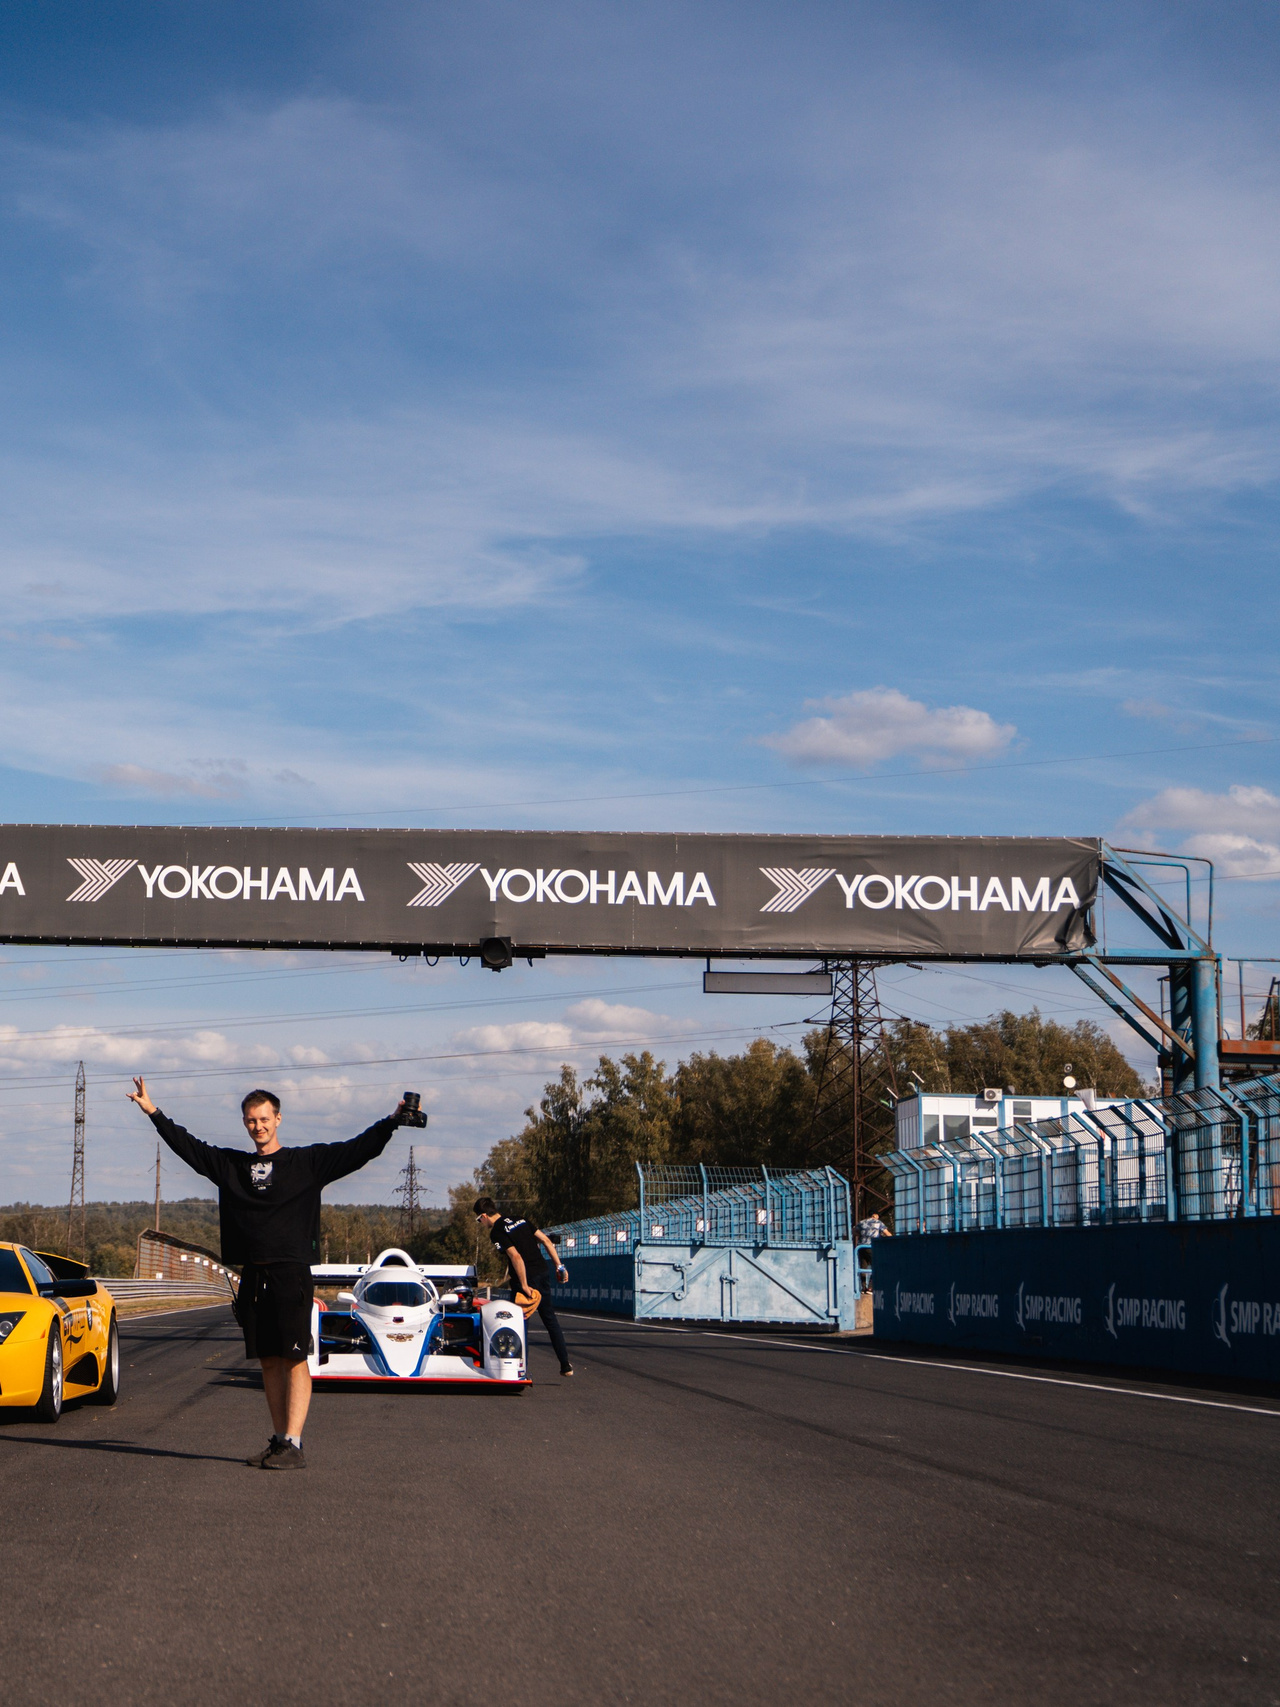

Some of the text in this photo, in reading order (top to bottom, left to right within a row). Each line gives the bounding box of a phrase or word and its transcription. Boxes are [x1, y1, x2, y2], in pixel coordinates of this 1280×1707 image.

[137, 864, 365, 902] YOKOHAMA
[479, 868, 717, 907] YOKOHAMA
[835, 873, 1081, 913] YOKOHAMA
[955, 1293, 999, 1318] SMP RACING
[1025, 1295, 1082, 1325] SMP RACING
[1117, 1298, 1186, 1330] SMP RACING
[1230, 1301, 1261, 1334] SMP
